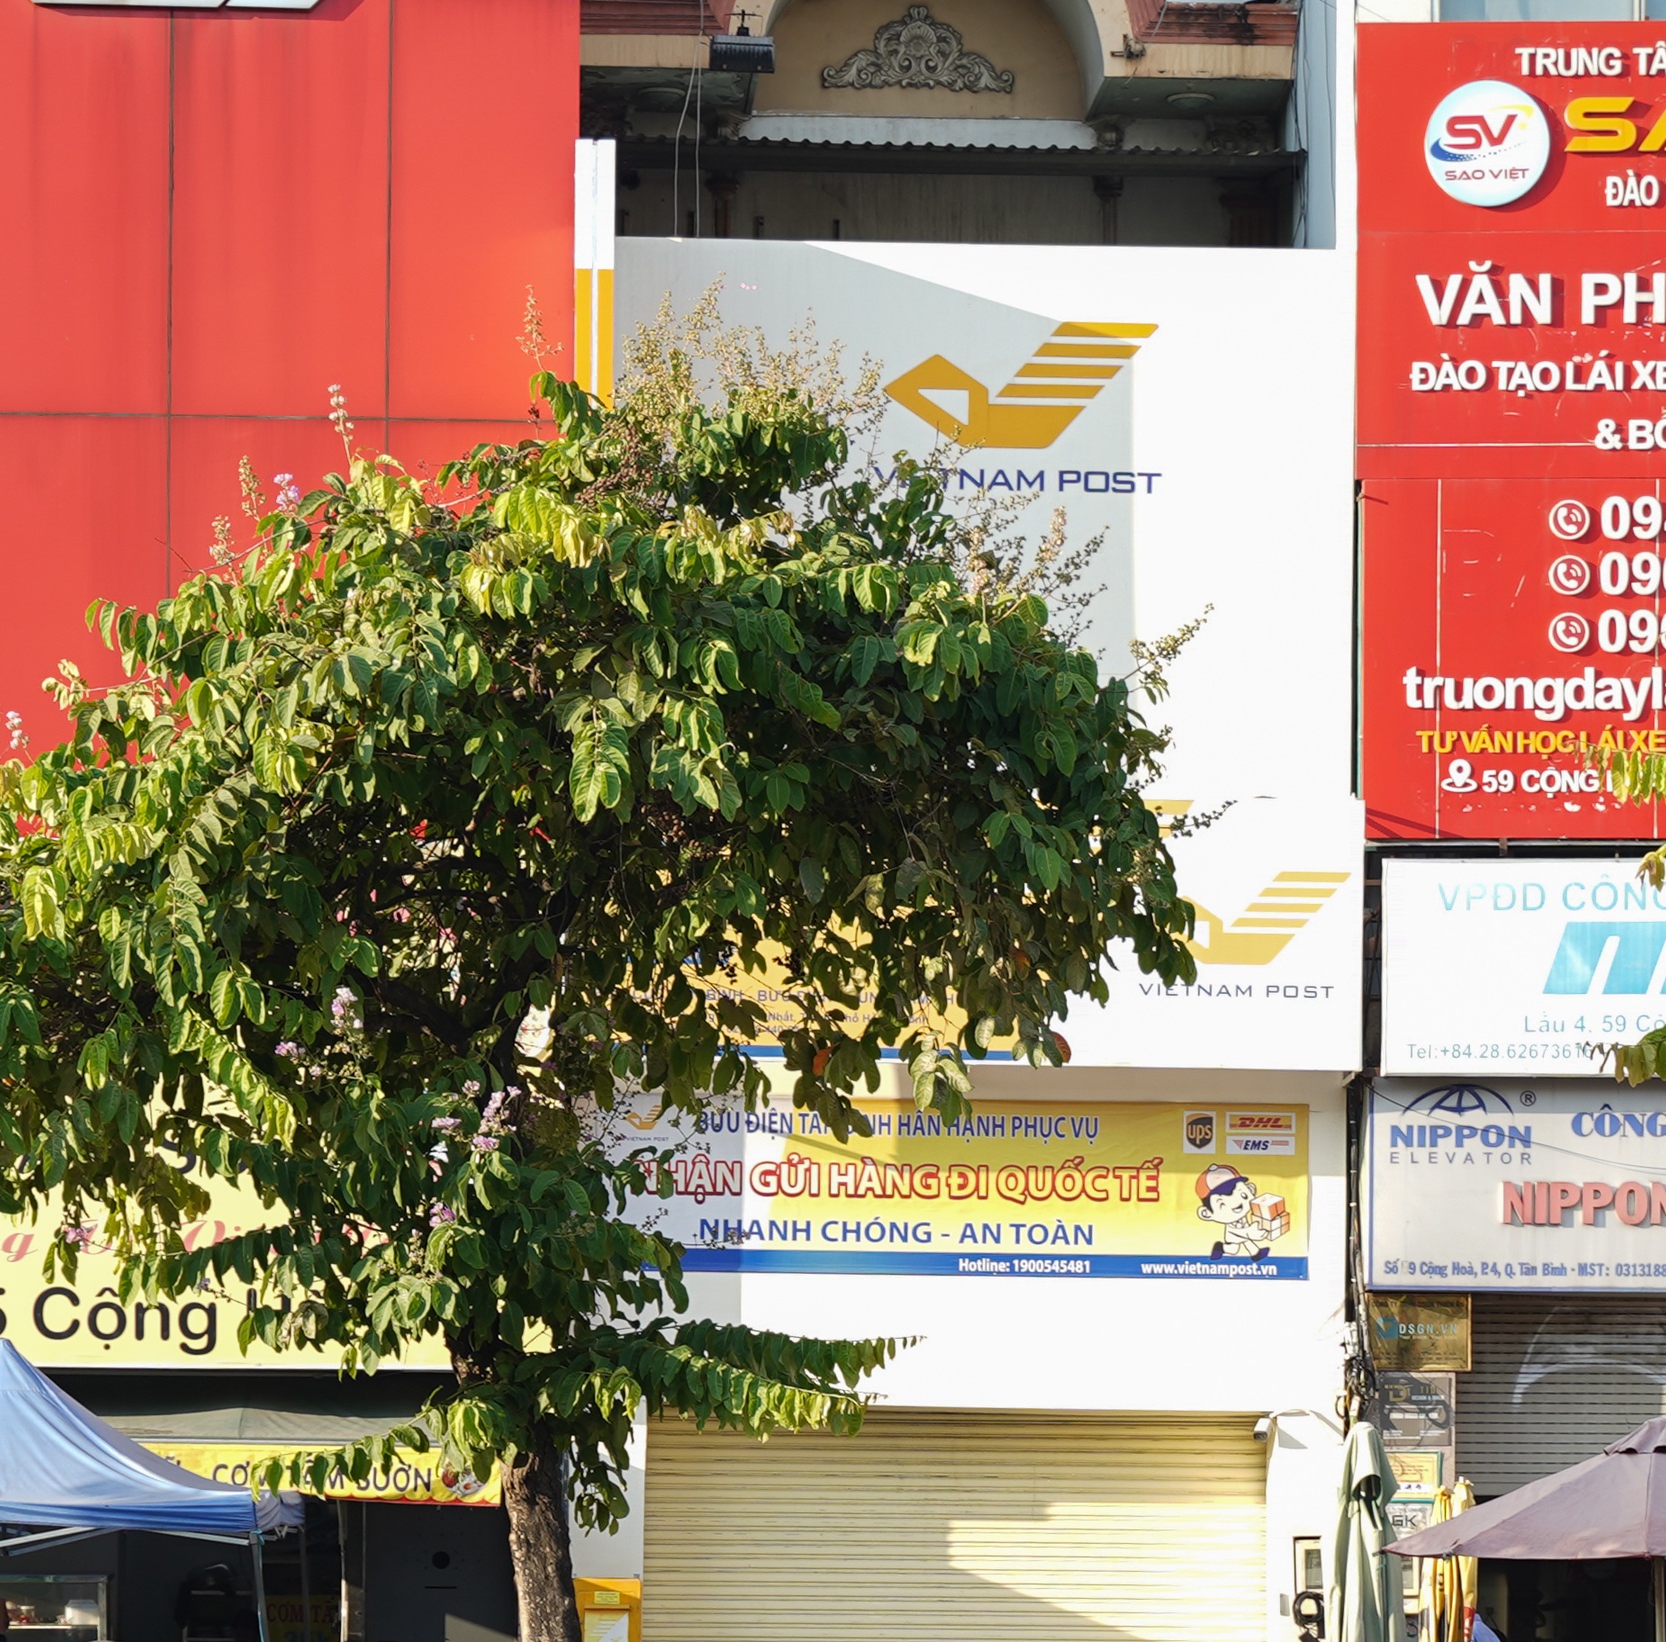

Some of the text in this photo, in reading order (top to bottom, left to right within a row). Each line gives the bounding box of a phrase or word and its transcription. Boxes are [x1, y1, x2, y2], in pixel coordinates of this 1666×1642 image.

[1516, 46, 1622, 77] TRUNG
[1443, 113, 1517, 150] SV
[1444, 166, 1530, 182] SAO VIỆT
[1605, 170, 1659, 206] ĐÀO
[1416, 260, 1552, 327] VĂN
[1410, 352, 1485, 393] ĐÀO
[1491, 360, 1563, 398] TẠO
[1565, 352, 1624, 393] LÁI
[1059, 470, 1162, 494] POST
[1461, 723, 1513, 753] VẤN
[1518, 730, 1575, 759] HỌC
[1629, 730, 1666, 753] XE
[1482, 770, 1514, 793] 59
[1521, 766, 1600, 797] CỘNG
[1437, 882, 1546, 911] VPĐD
[1139, 981, 1334, 1000] VIETNAM POST
[1602, 1015, 1627, 1033] 59
[745, 1107, 793, 1140] ĐIỆN
[898, 1109, 941, 1137] HÂN
[1012, 1114, 1066, 1145] PHỤC
[1072, 1115, 1099, 1145] VỤ
[1187, 1124, 1212, 1150] ups
[1238, 1116, 1285, 1129] DHL
[1390, 1123, 1532, 1149] NIPPON
[1243, 1139, 1270, 1152] EMS
[1390, 1151, 1533, 1165] ELEVATOR
[750, 1152, 821, 1197] GỬI
[829, 1157, 940, 1199] HÀNG
[946, 1164, 989, 1199] ĐI
[996, 1156, 1110, 1205] QUỐC
[1113, 1157, 1164, 1202] TẾ
[699, 1214, 1094, 1246] NHANH CHÓNG AN TOÀN
[959, 1258, 1278, 1279] Hotline: 1900545481 www.vietnampost.vn
[1419, 1261, 1447, 1280] Cộng
[1578, 1263, 1611, 1277] MST:
[33, 1286, 218, 1357] Cộng
